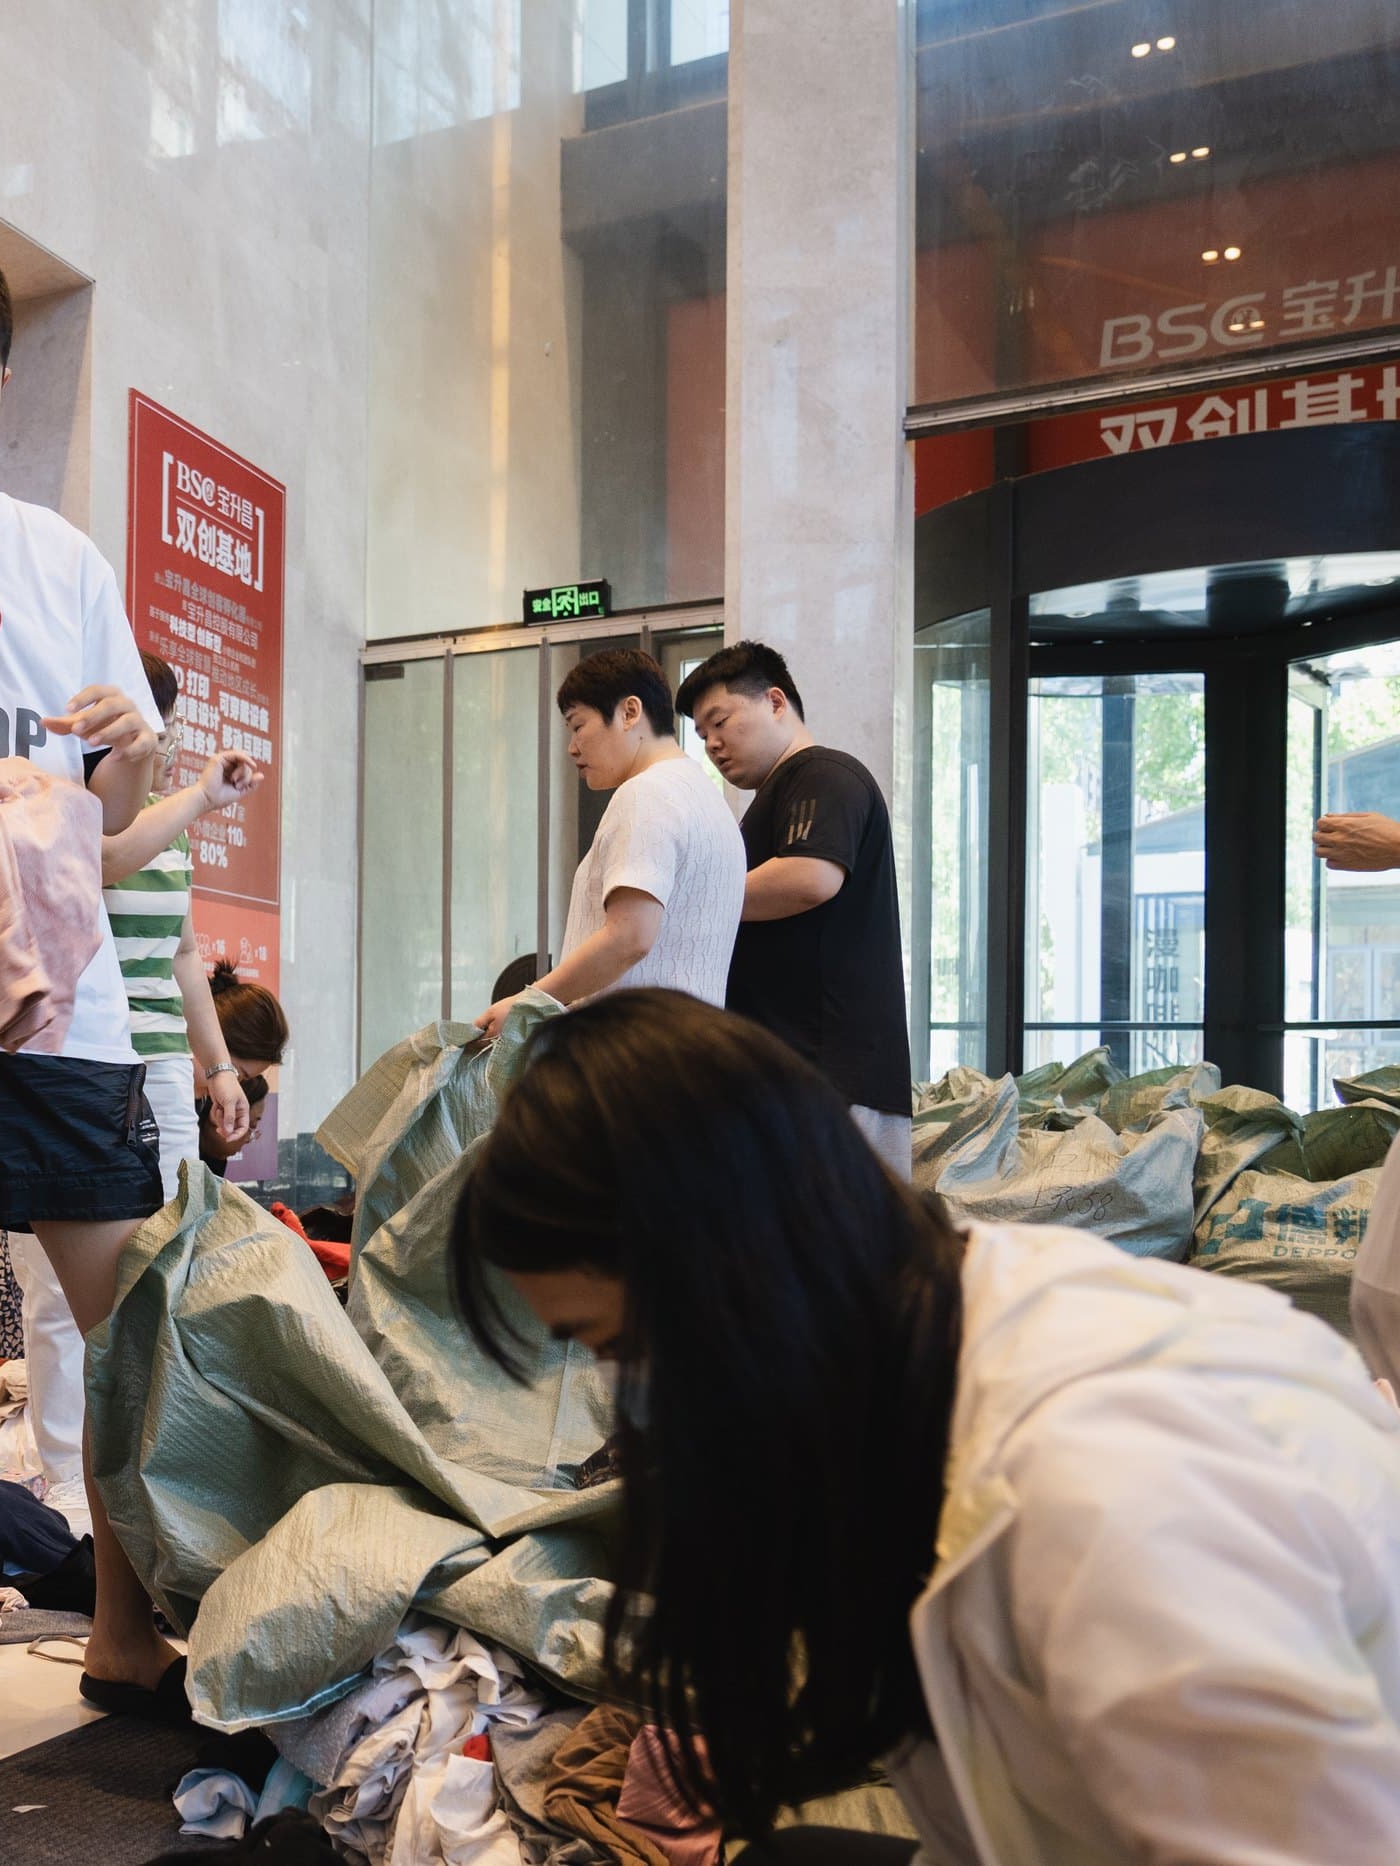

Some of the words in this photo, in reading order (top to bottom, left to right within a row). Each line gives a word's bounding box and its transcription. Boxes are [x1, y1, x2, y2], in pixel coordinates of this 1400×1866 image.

[216, 485, 254, 531] 宝升昌
[175, 507, 252, 587] 双创基地
[531, 597, 552, 613] 安全
[579, 590, 600, 607] 出口
[186, 668, 210, 700] 打印
[218, 690, 270, 734] 可穿戴设备
[222, 723, 273, 765] 移动互联网
[199, 840, 229, 869] 80%
